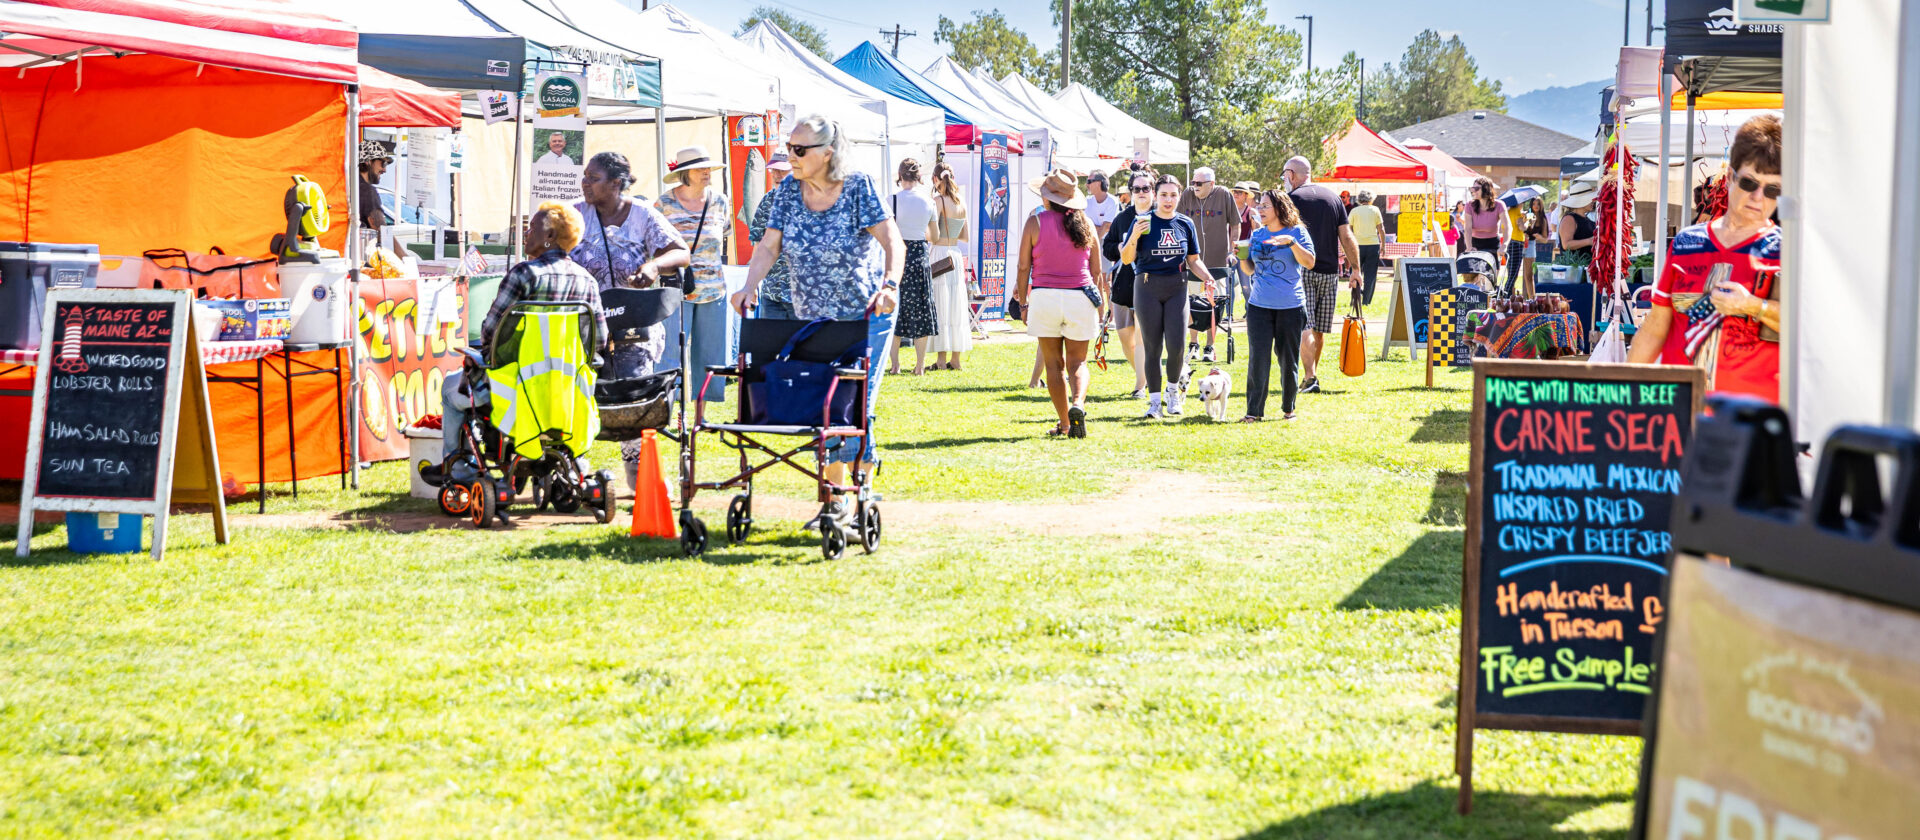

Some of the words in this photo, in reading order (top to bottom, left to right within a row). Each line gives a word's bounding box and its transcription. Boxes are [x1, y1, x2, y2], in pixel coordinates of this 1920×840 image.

[1748, 24, 1784, 33] SHADES
[542, 95, 577, 104] LASAGNA
[537, 170, 577, 179] Handmade
[538, 178, 576, 186] all-natural
[557, 185, 581, 193] frozen
[1409, 202, 1426, 211] TEA
[983, 229, 995, 241] SIGN
[995, 229, 1007, 241] UP
[1158, 229, 1182, 248] A
[982, 242, 997, 258] FOR
[998, 242, 1006, 258] A
[982, 259, 1006, 277] FREE
[981, 277, 1005, 295] HVAC
[95, 308, 143, 323] TASTE
[147, 309, 168, 322] OF
[603, 306, 625, 318] drive
[84, 324, 131, 338] MAINE
[135, 325, 159, 338] AZ
[53, 375, 114, 392] LOBSTER
[118, 376, 154, 390] ROLLS
[389, 366, 460, 433] COR
[1530, 379, 1569, 404] WITH
[1638, 384, 1679, 405] BEEF
[132, 430, 161, 445] ROLLS
[1493, 408, 1596, 455] CARNE
[1605, 409, 1684, 466] SECA
[50, 458, 85, 472] SUN
[93, 458, 130, 474] TEA
[1493, 491, 1580, 523] INSPIRED
[1584, 496, 1645, 527] DRIED
[1498, 524, 1577, 553] CRISPY
[1584, 528, 1637, 555] BEEF
[1636, 530, 1674, 556] JER
[1496, 580, 1635, 617] Handcrafted
[1519, 618, 1545, 644] in
[1543, 612, 1624, 642] Tucson
[1551, 645, 1656, 687] Sample
